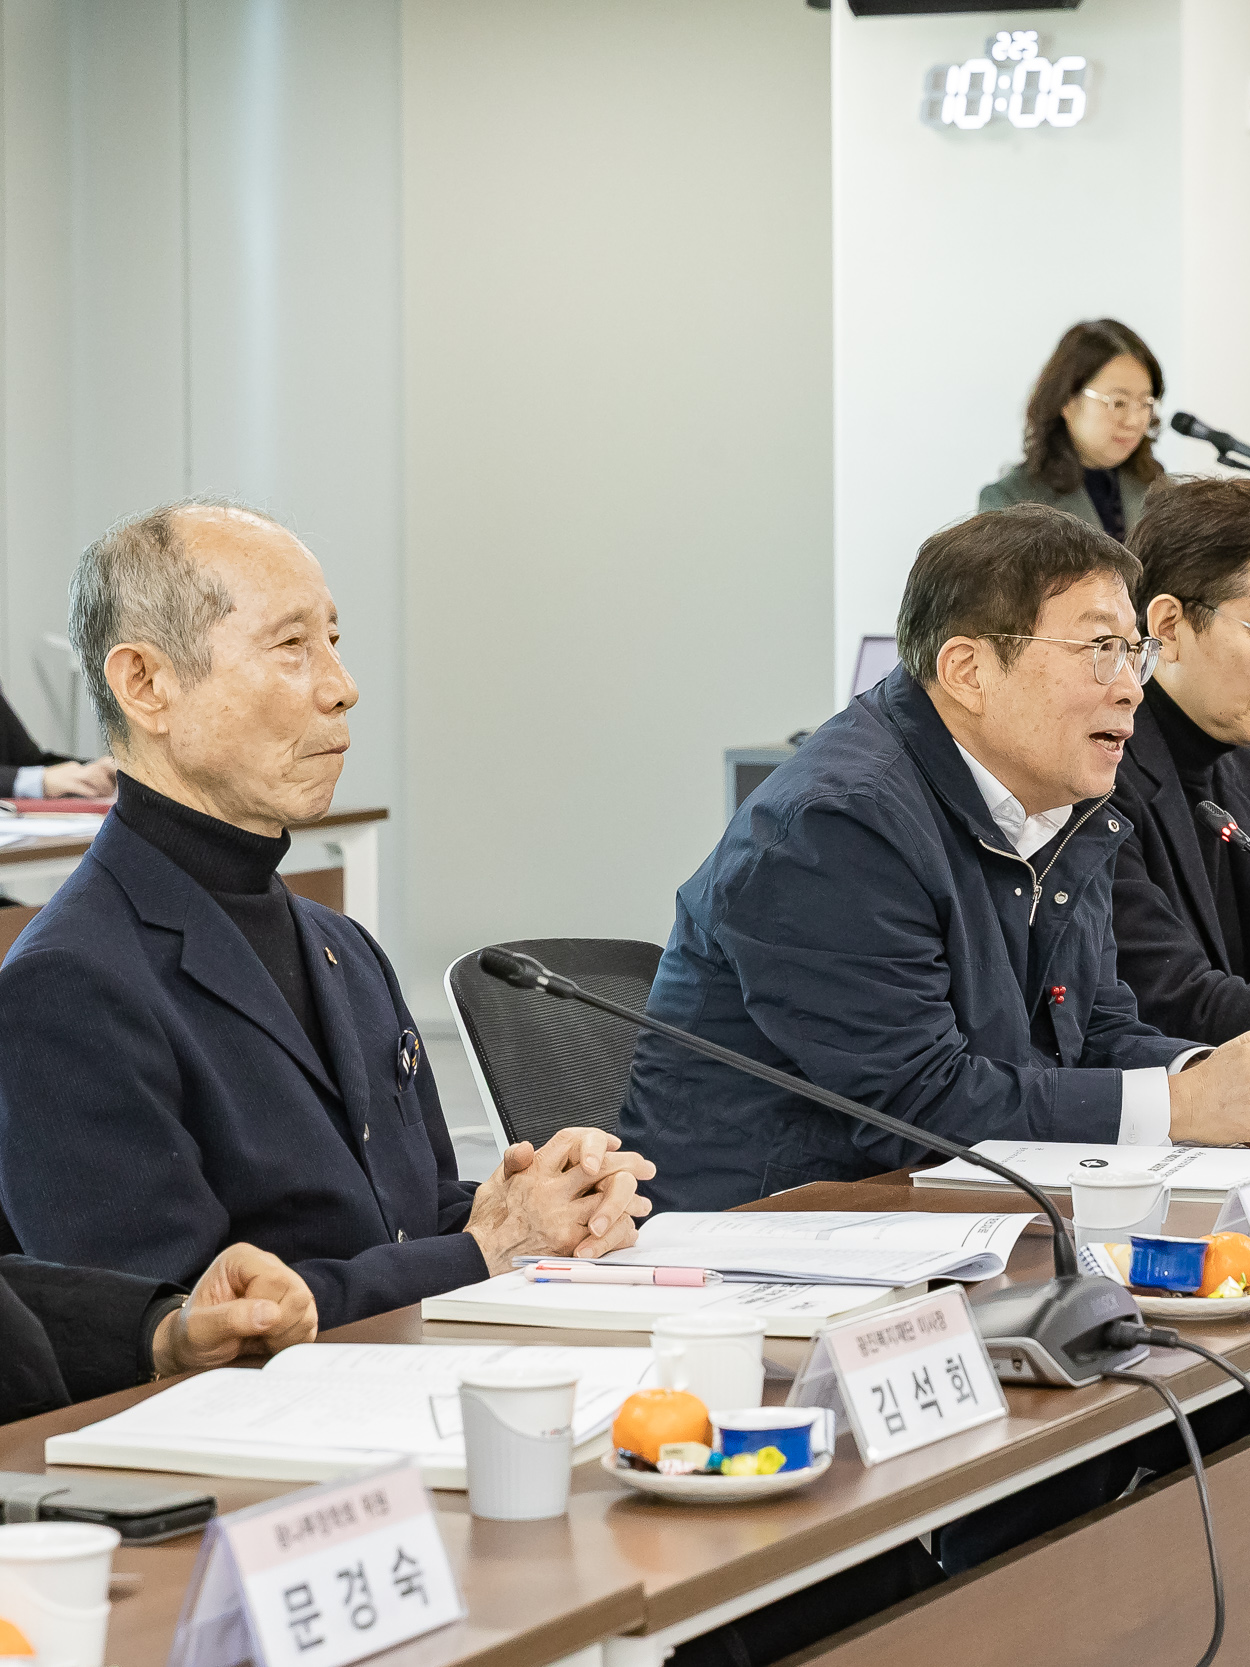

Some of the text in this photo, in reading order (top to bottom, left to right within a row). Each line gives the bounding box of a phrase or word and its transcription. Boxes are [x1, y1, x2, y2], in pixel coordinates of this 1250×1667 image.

[942, 56, 1086, 129] 10:06
[917, 1309, 948, 1336] 이사장
[871, 1353, 978, 1437] 김석회
[282, 1546, 429, 1652] 문경숙
